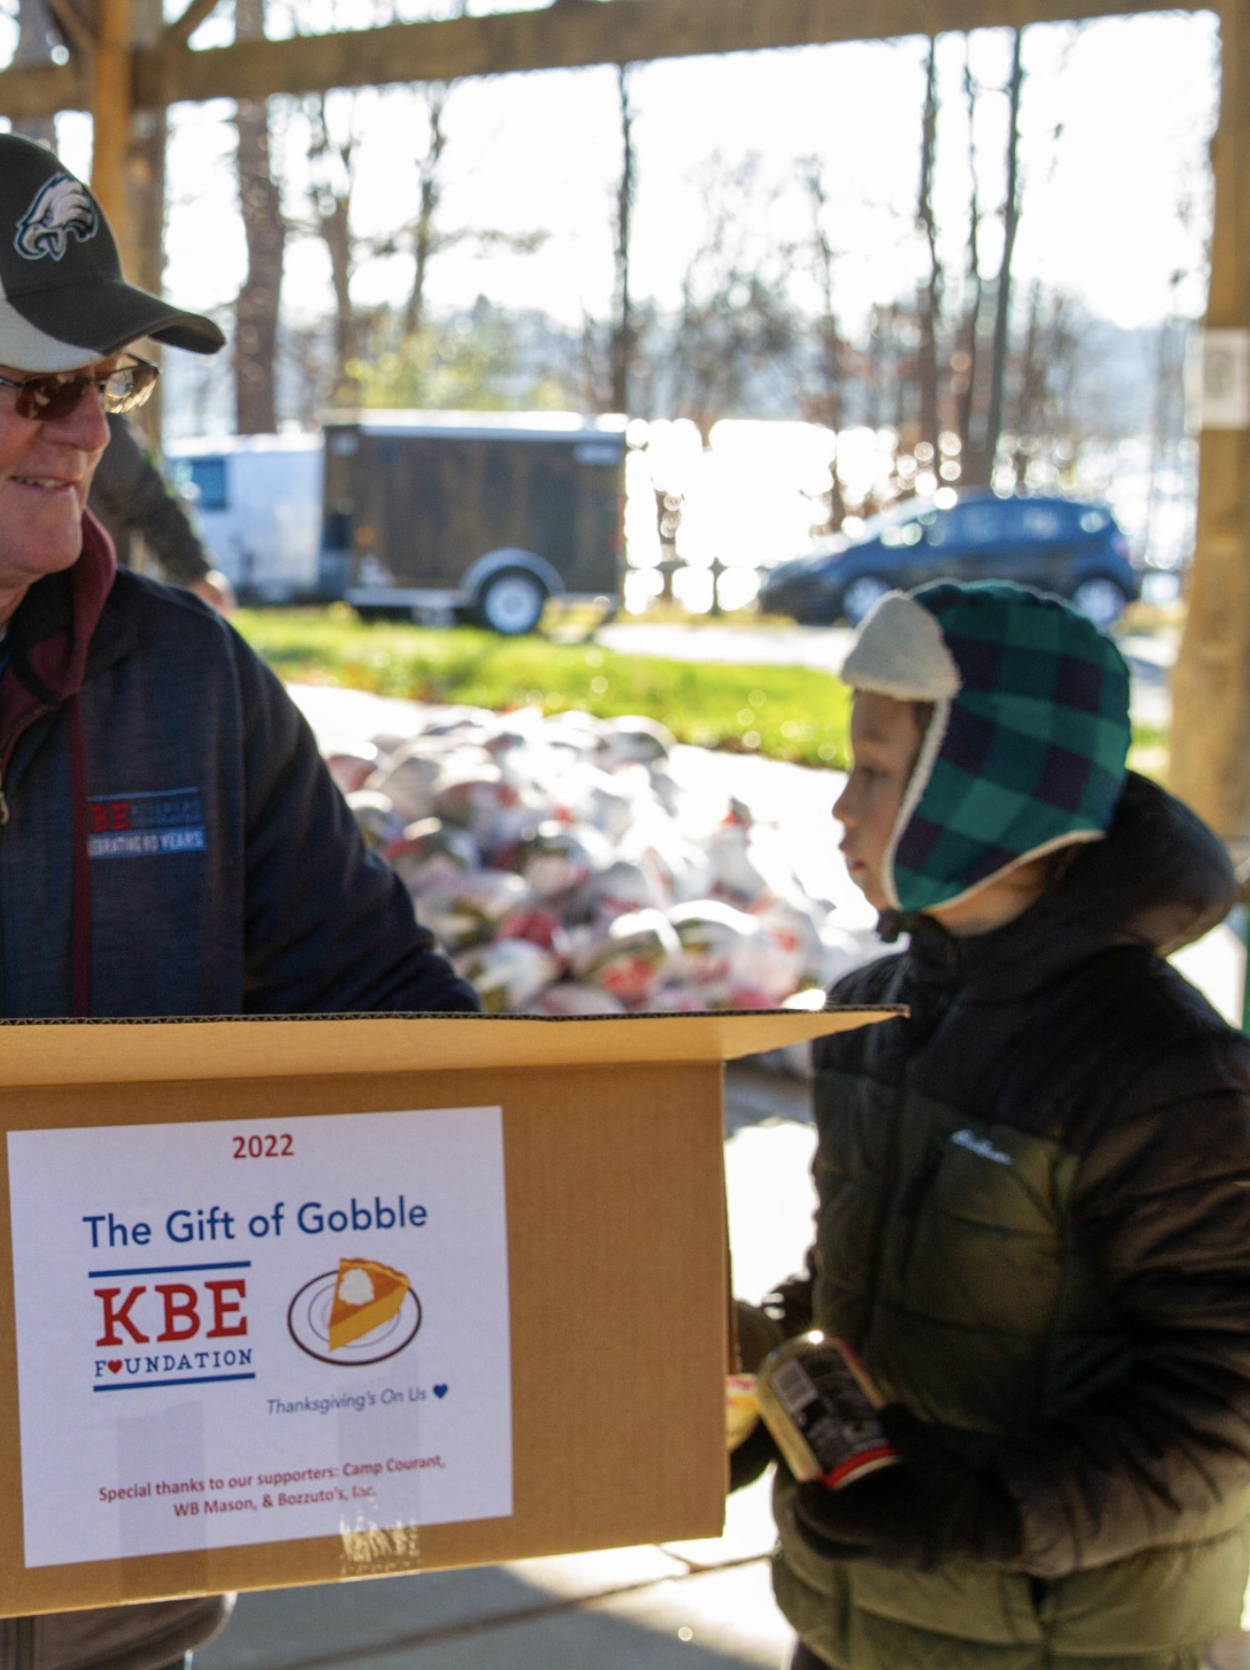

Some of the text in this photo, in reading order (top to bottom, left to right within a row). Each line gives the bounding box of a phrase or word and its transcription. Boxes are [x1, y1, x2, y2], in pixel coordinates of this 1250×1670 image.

[90, 801, 131, 833] BE
[232, 1133, 295, 1160] 2022
[83, 1195, 428, 1248] The Gift of Gobble
[94, 1279, 249, 1348] KBE
[266, 1386, 427, 1415] Thanksgiving's On Us
[99, 1454, 446, 1504] Special thanks to our supporters: Camp Courant,
[173, 1501, 200, 1517] WB
[204, 1498, 258, 1514] Mason,
[262, 1493, 273, 1508] &
[277, 1487, 349, 1507] Bozzuto's,
